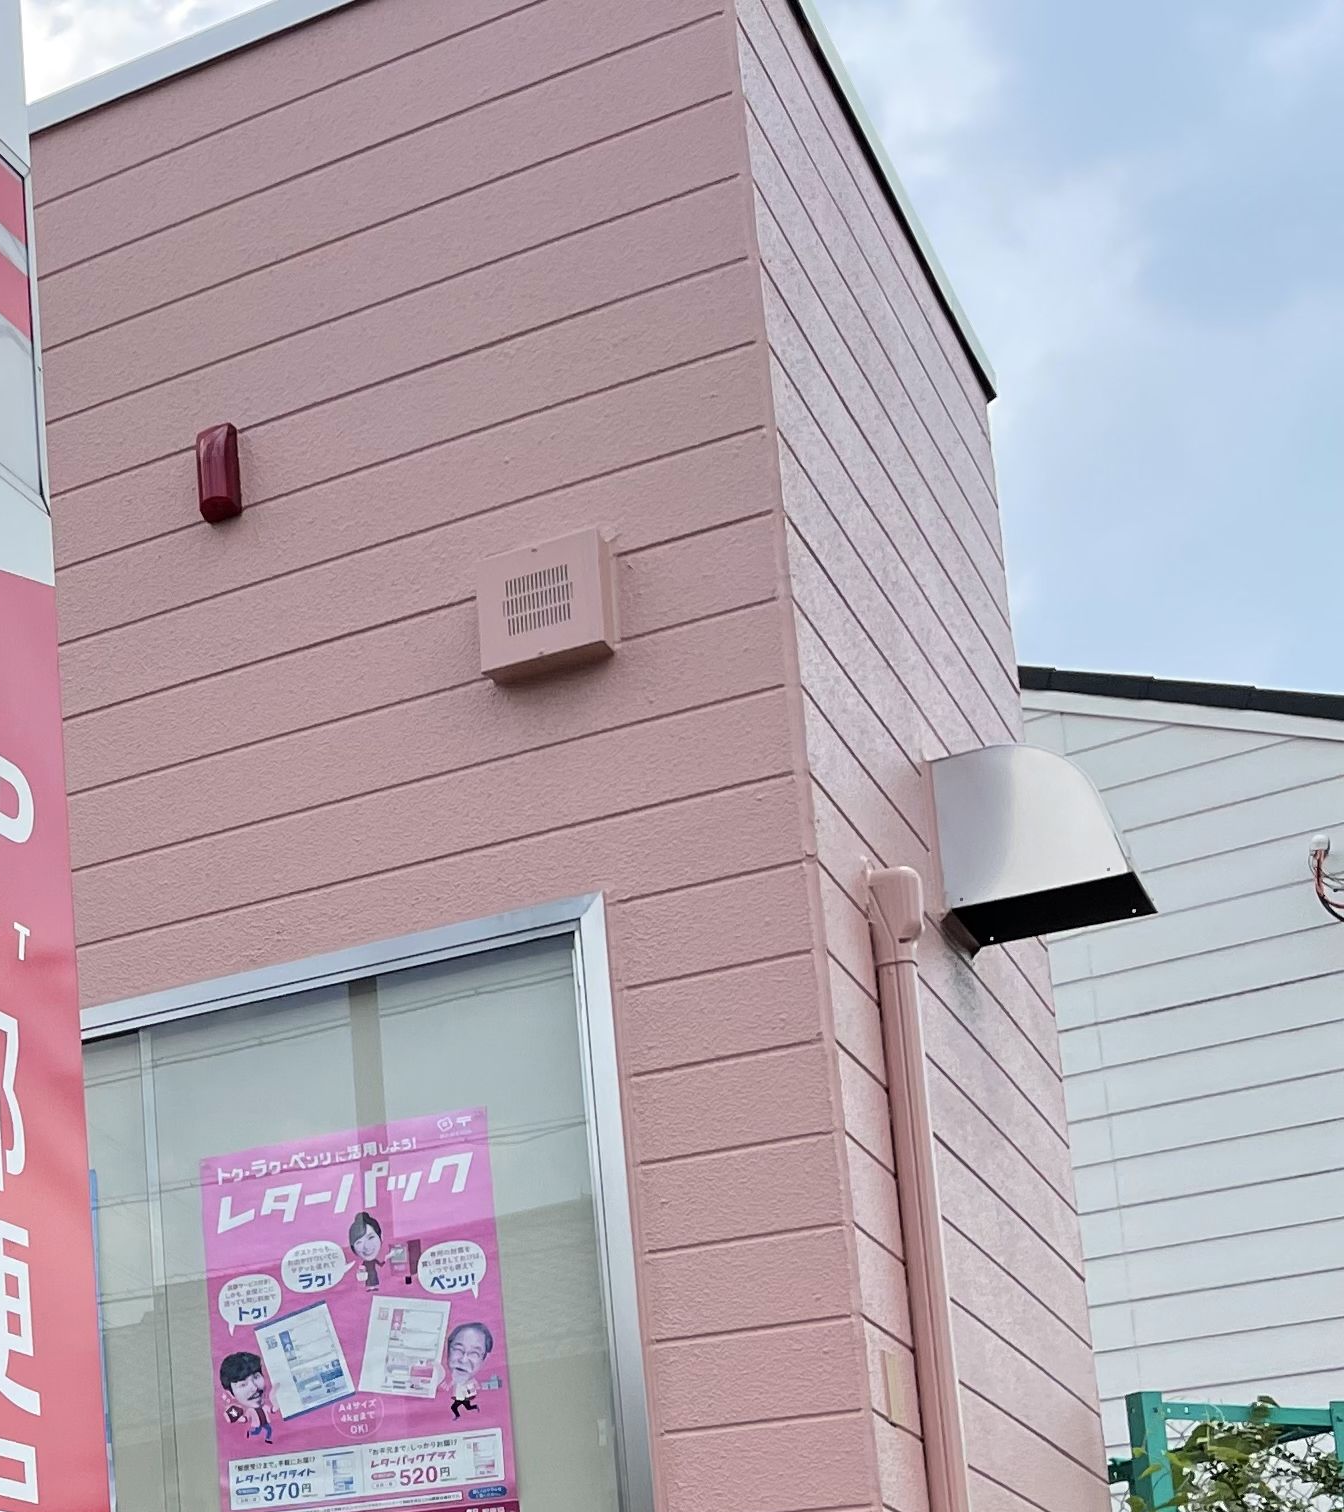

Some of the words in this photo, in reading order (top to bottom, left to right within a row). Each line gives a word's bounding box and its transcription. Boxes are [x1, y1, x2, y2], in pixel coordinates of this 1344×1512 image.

[217, 1151, 474, 1234] レターパック
